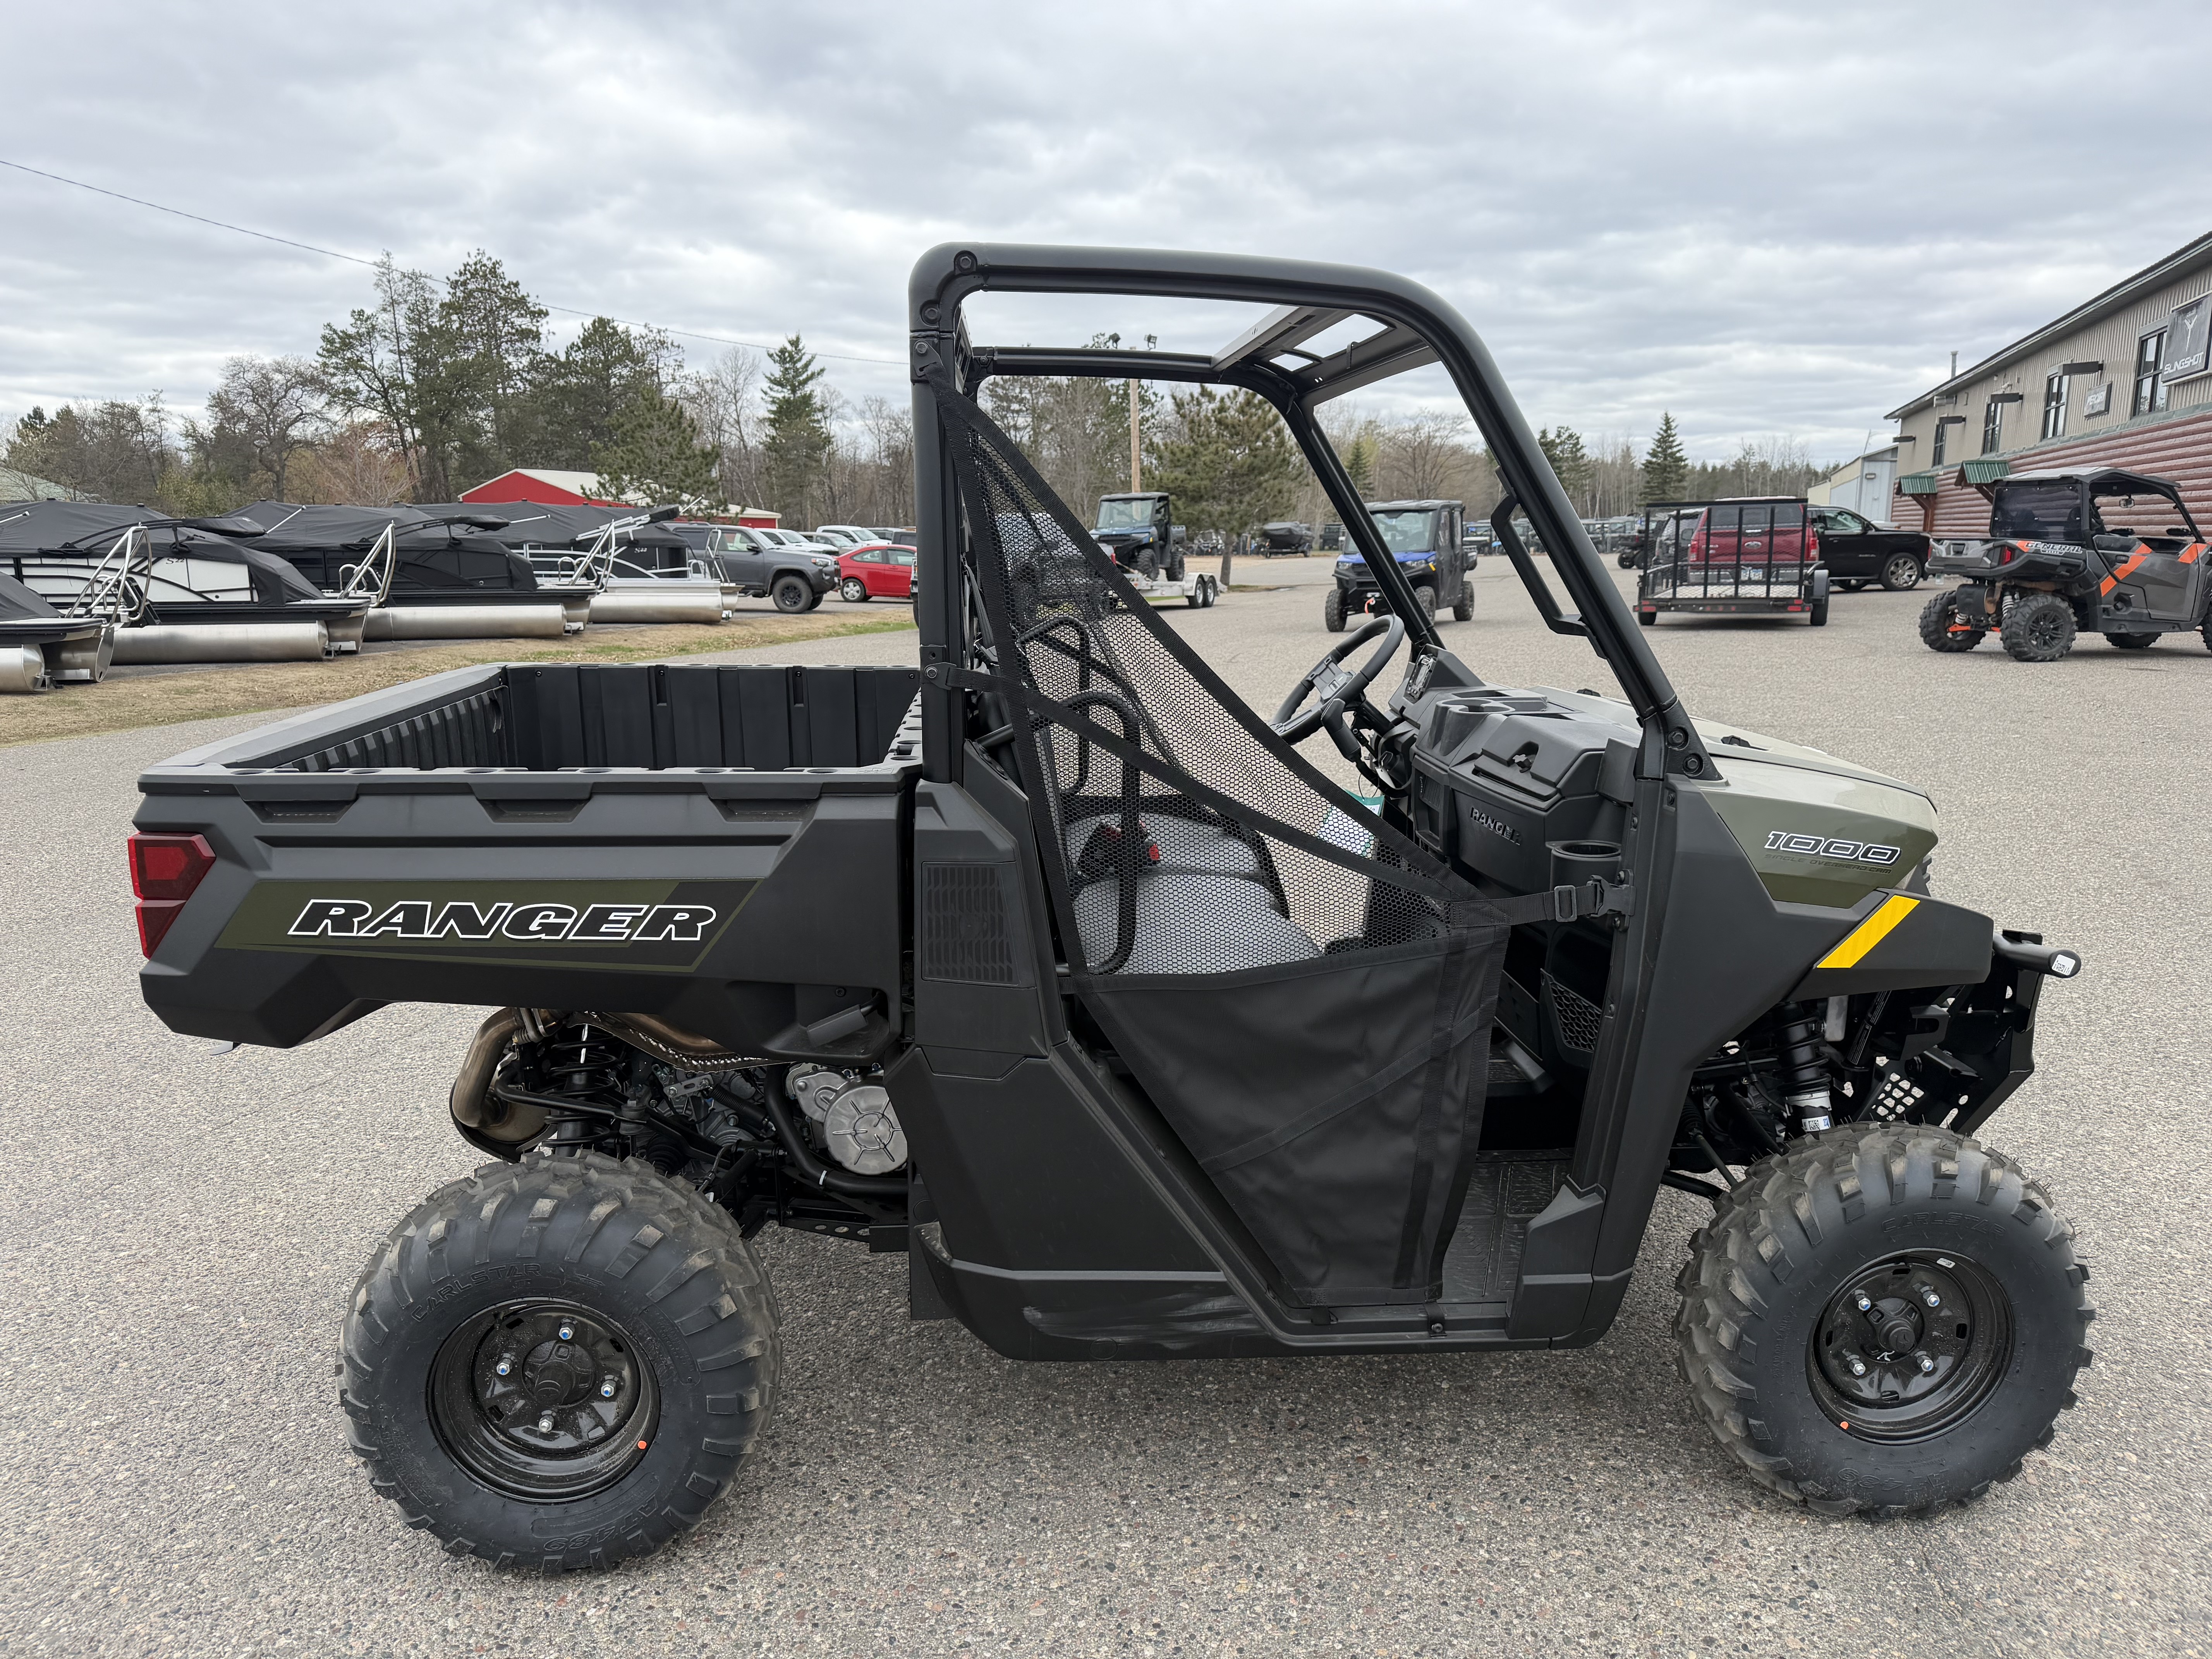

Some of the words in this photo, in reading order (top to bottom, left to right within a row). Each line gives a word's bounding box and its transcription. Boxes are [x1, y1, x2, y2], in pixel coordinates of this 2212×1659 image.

[2163, 351, 2204, 375] SLINGSHOT
[2025, 541, 2083, 554] GENERAL
[1470, 806, 1522, 845] RANGER
[1764, 831, 1901, 865] 1000
[1764, 853, 1806, 863] SINGLE
[1810, 860, 1868, 871] OVERHEAD
[288, 898, 716, 942] RANGER
[1882, 1212, 2006, 1236] CARLSTAR
[411, 1263, 542, 1322] CARLSTAR
